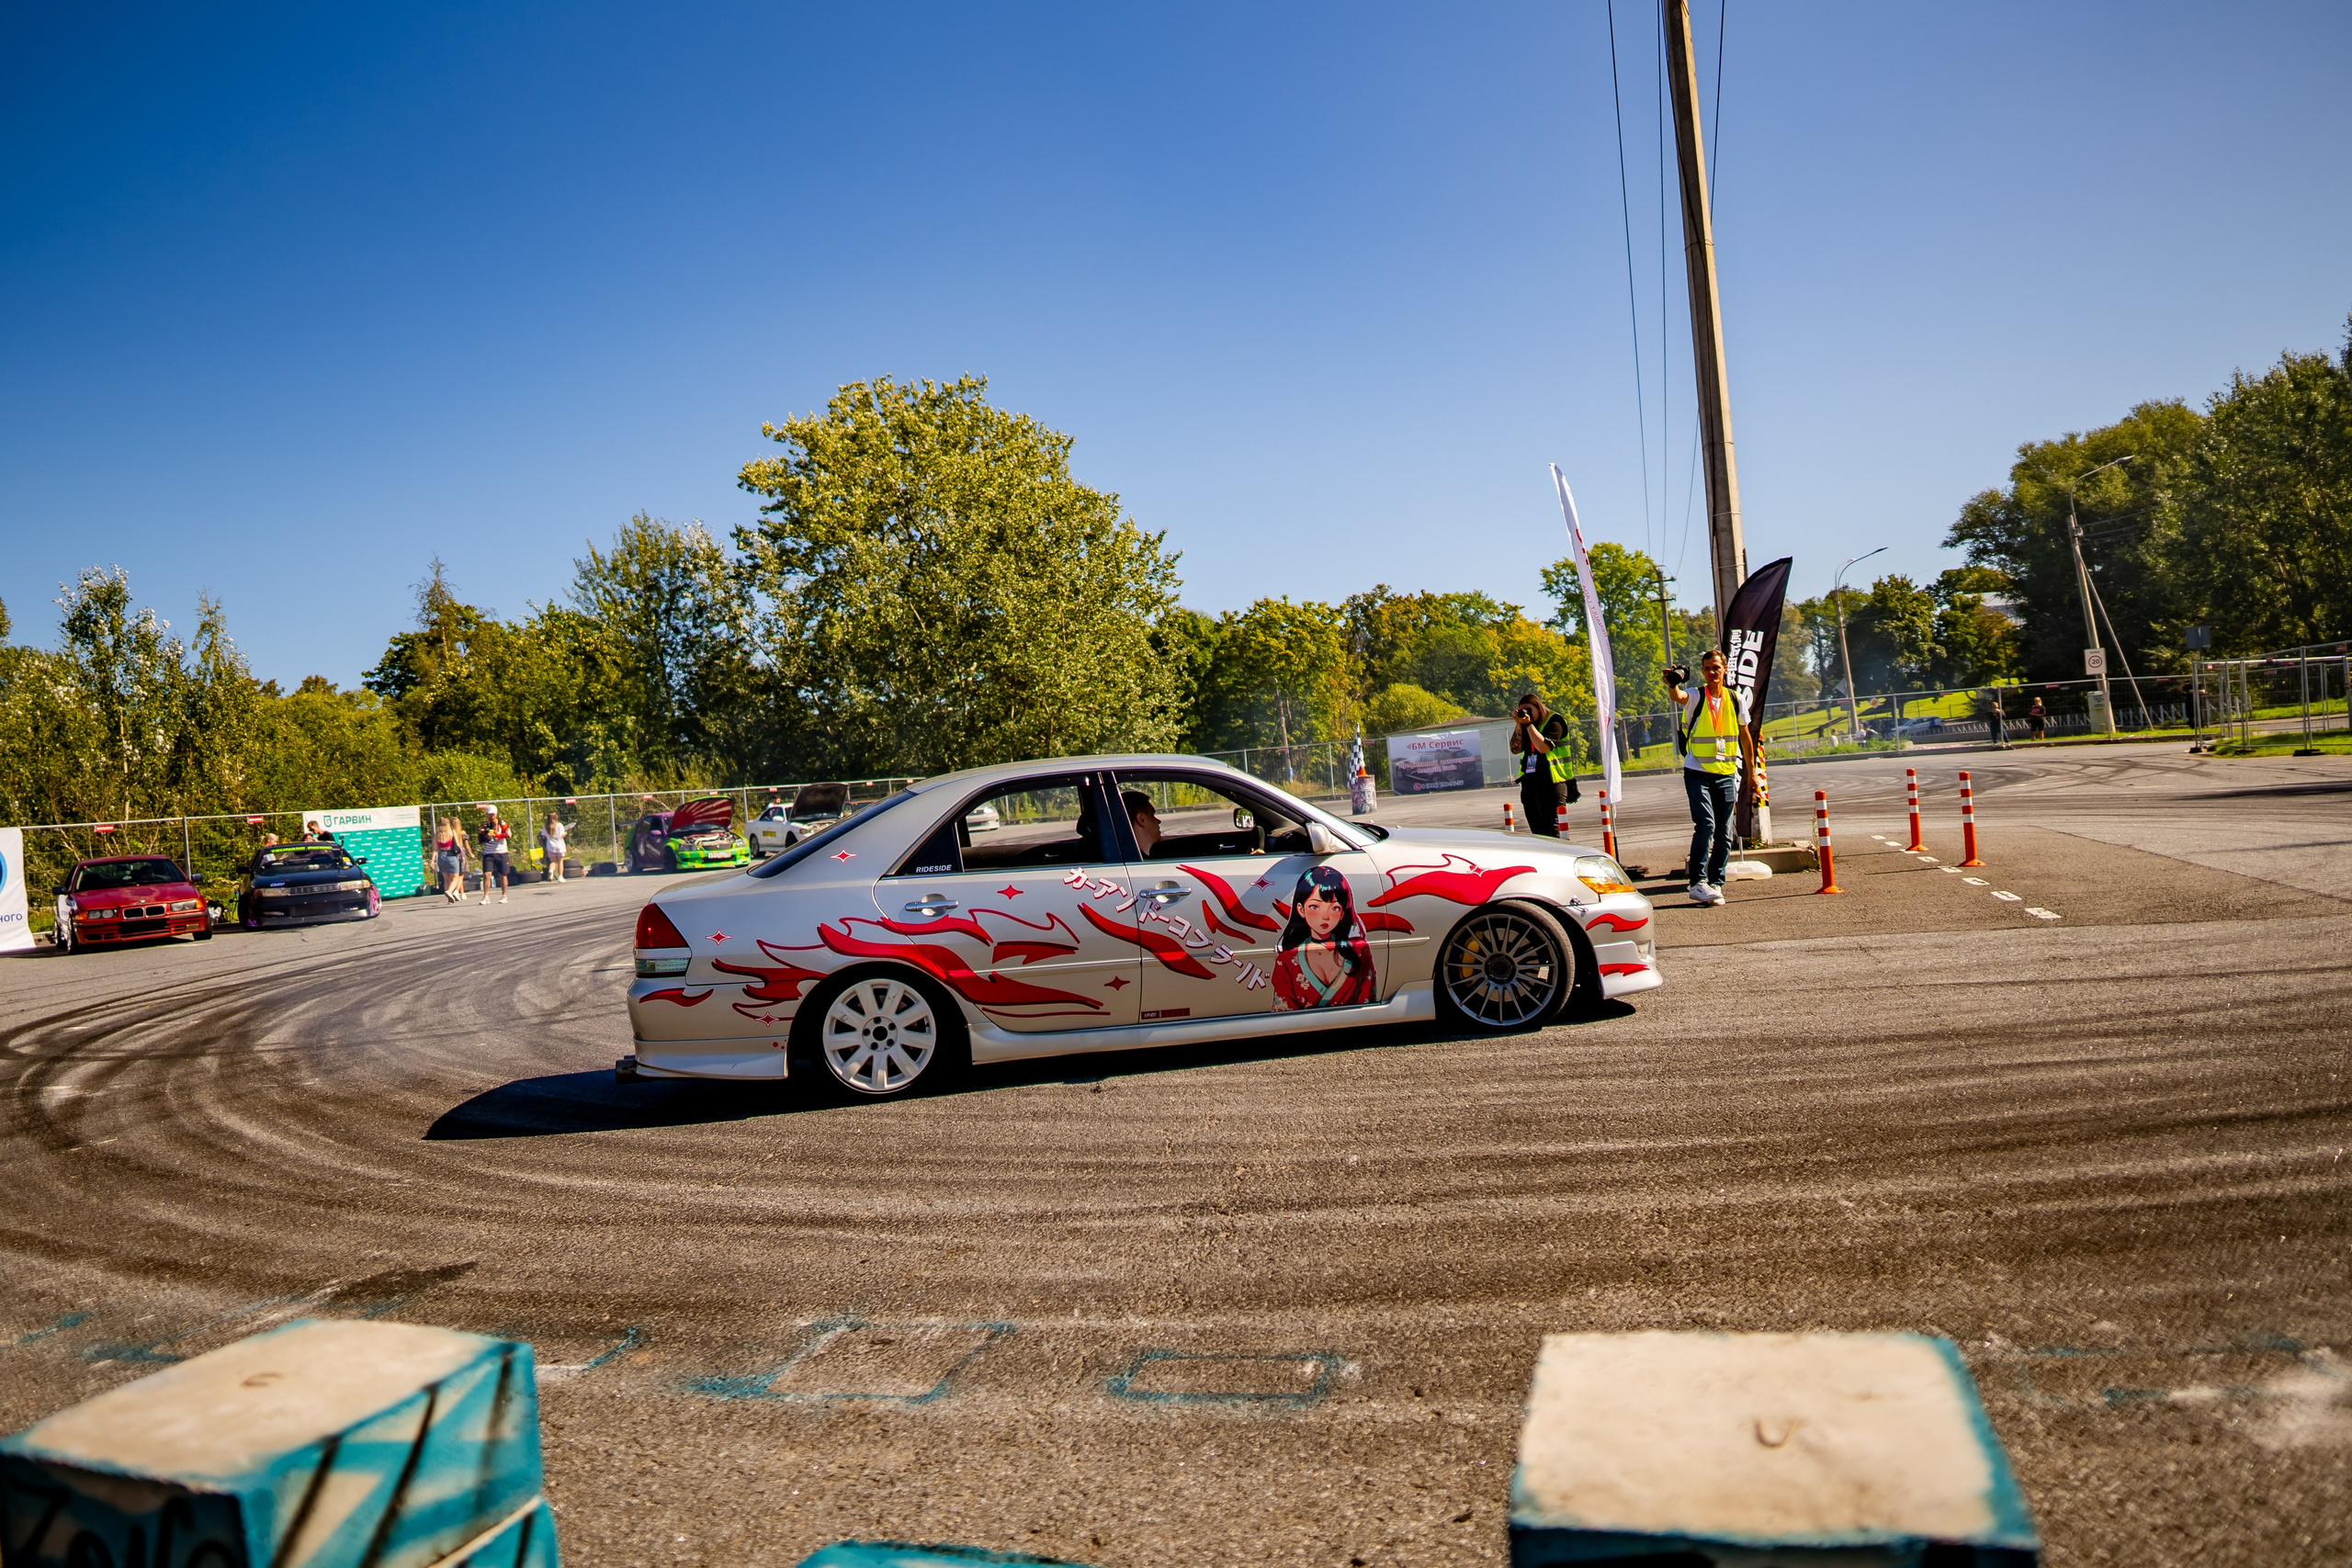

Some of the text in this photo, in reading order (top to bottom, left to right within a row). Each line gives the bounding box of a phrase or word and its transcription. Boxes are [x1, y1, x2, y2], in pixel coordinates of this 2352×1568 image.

[1411, 739, 1464, 750] БМ Сервис
[334, 815, 372, 825] ГАРВИН
[916, 864, 952, 873] RIDESIDE
